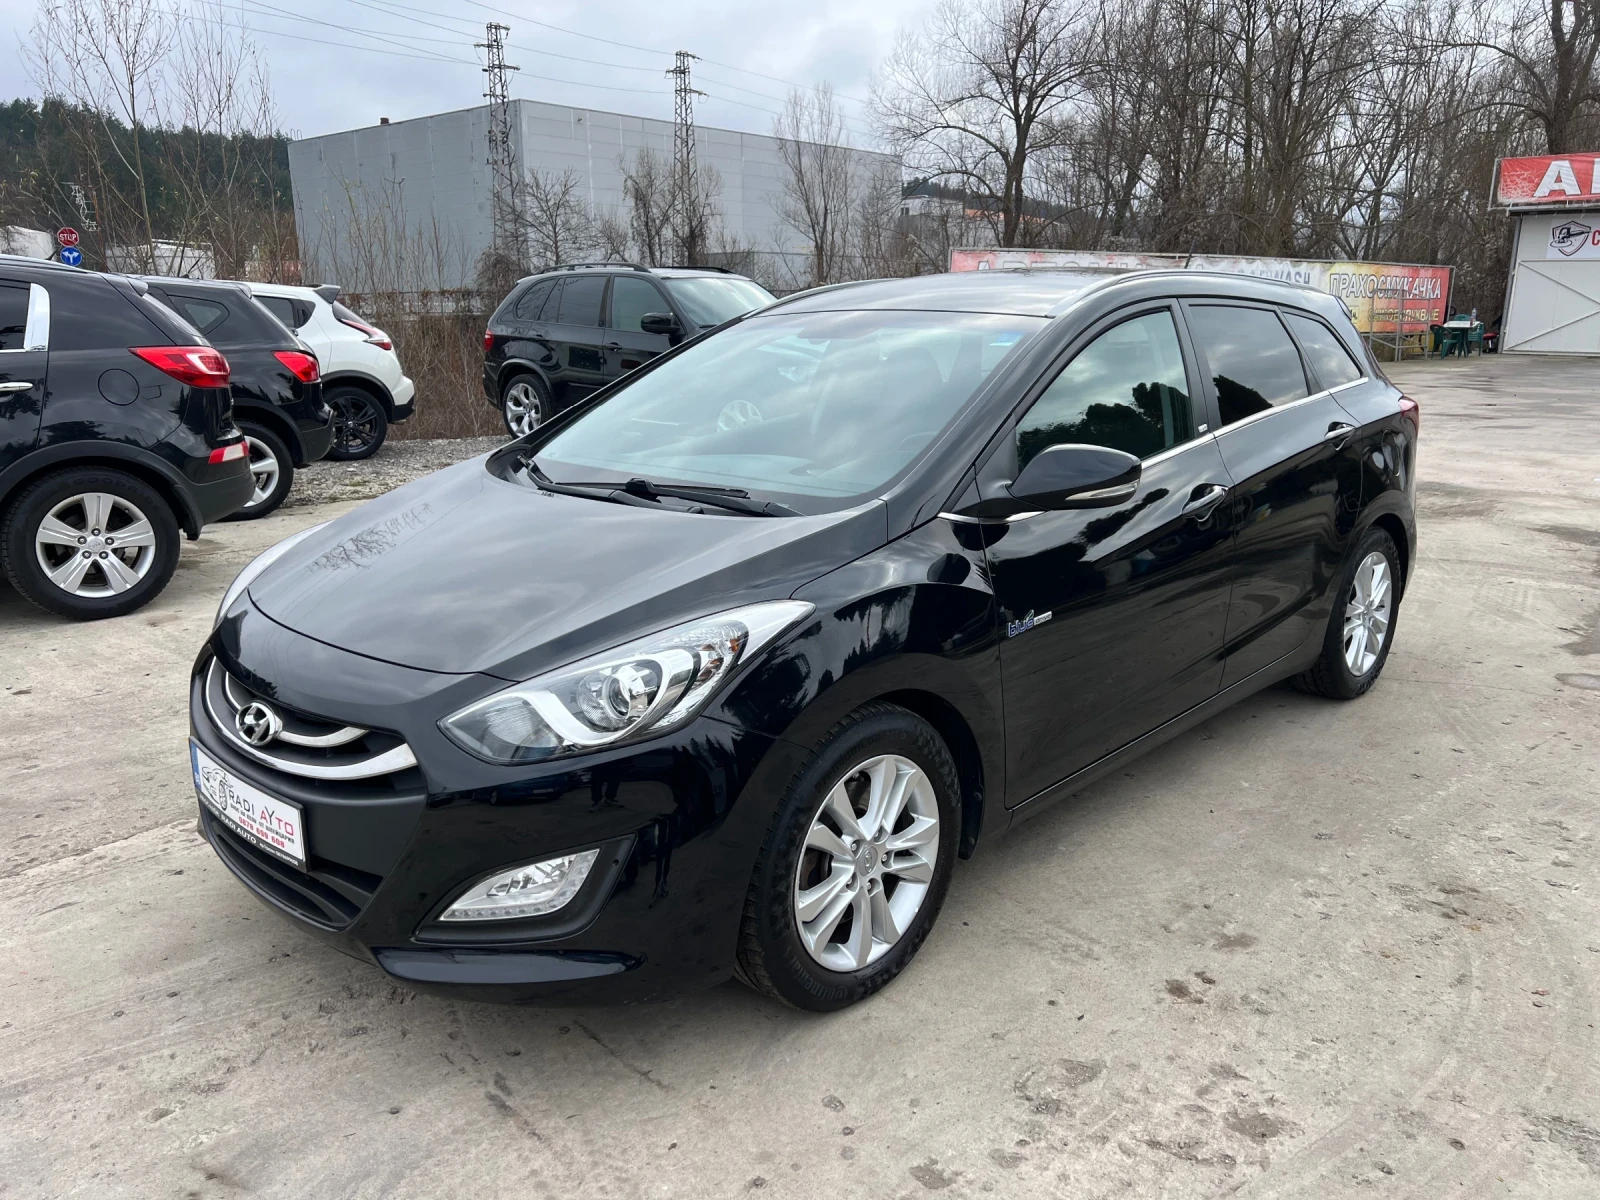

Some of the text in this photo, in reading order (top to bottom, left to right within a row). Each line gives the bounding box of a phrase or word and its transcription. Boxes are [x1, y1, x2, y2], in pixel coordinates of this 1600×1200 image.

[1533, 157, 1600, 197] А
[60, 233, 77, 241] STOP
[1329, 272, 1441, 300] ПРАХОСМУКАЧКА
[1008, 619, 1034, 638] blue
[228, 789, 255, 816] RADI
[221, 814, 257, 844] RADI AUTO
